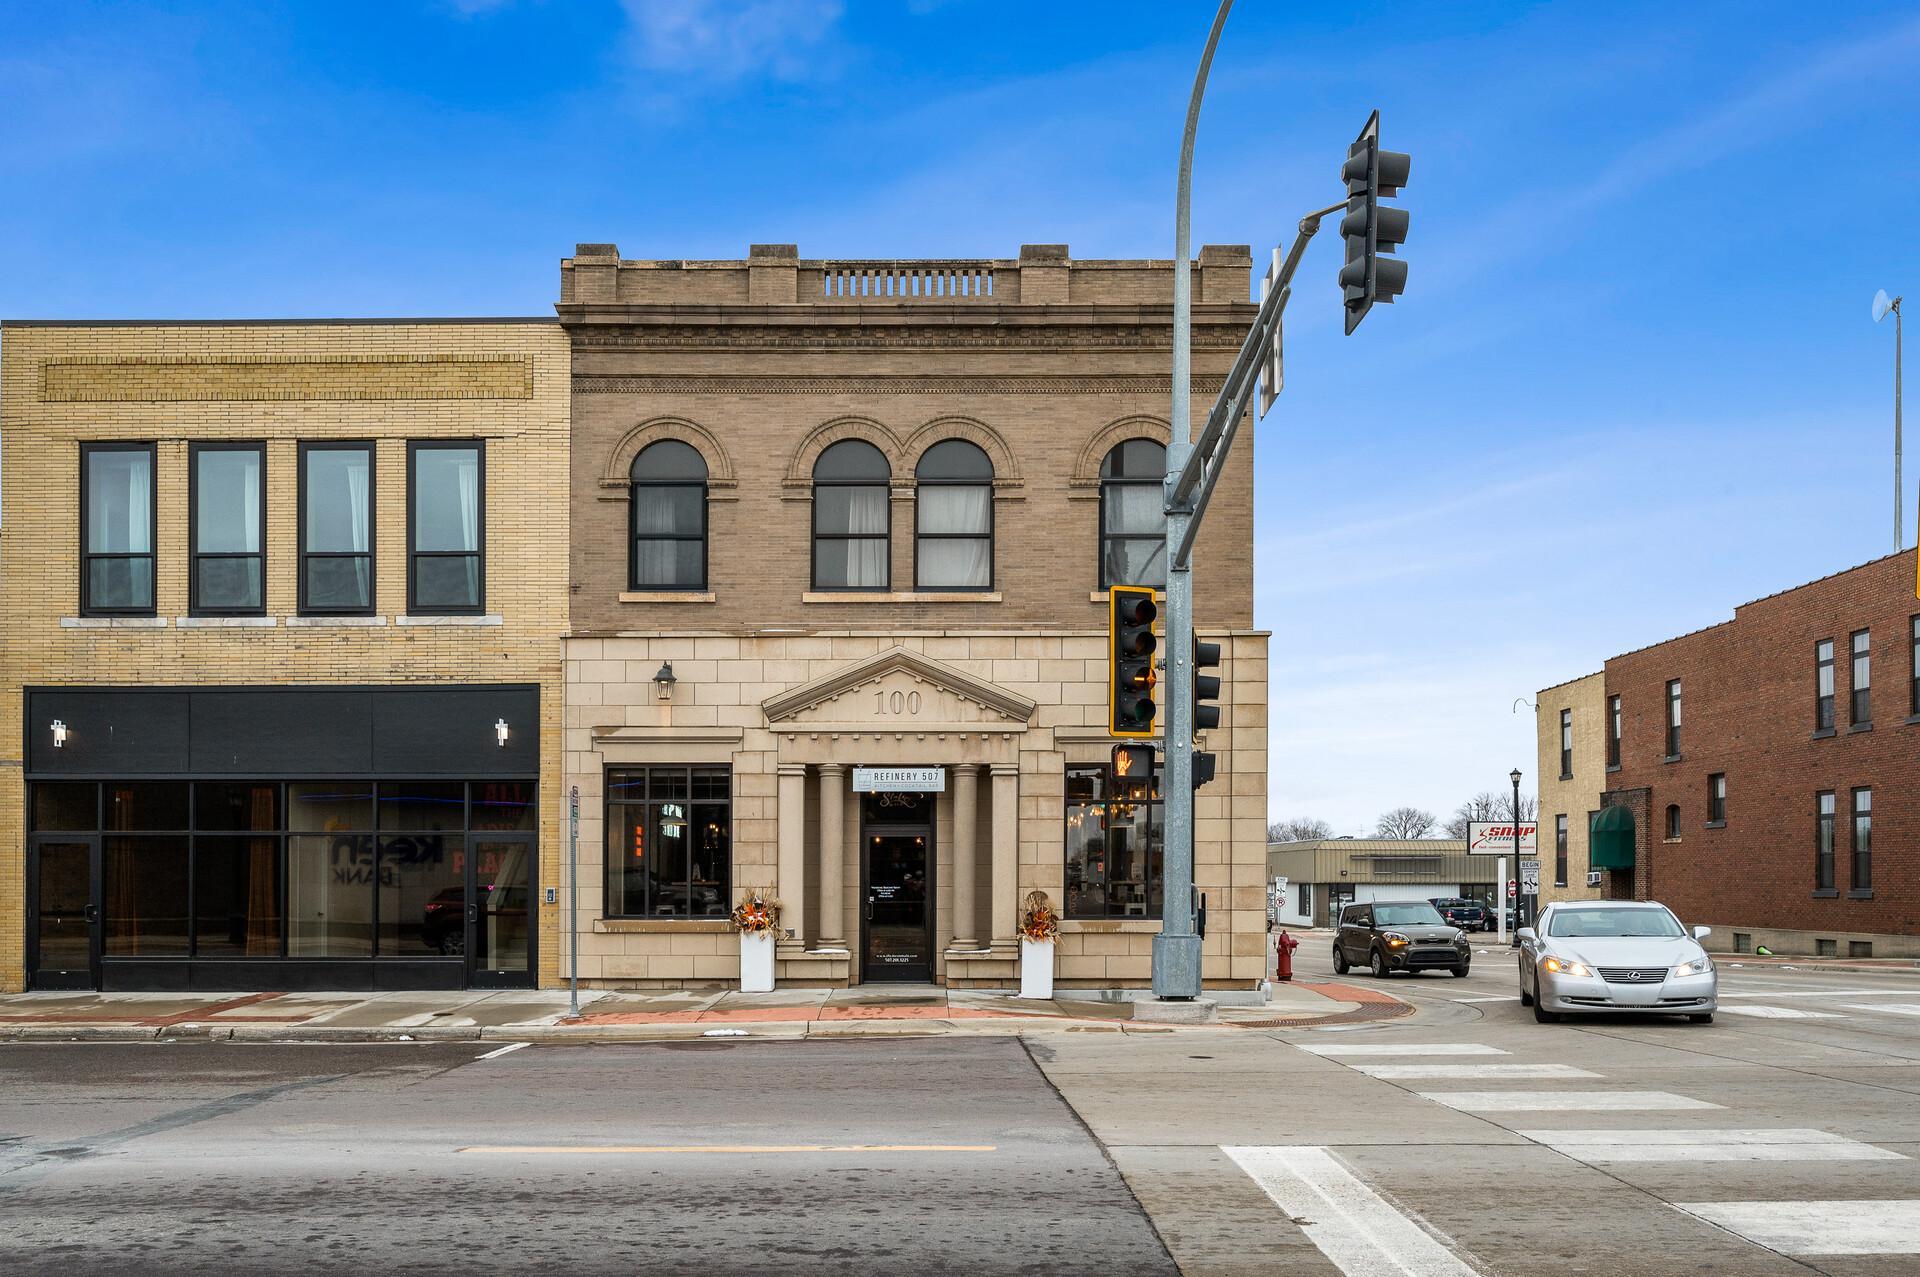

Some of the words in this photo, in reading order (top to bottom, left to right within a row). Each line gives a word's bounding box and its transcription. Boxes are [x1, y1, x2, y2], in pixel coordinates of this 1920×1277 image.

[874, 691, 922, 715] 100
[874, 772, 918, 781] REFINERY
[922, 772, 939, 781] 507
